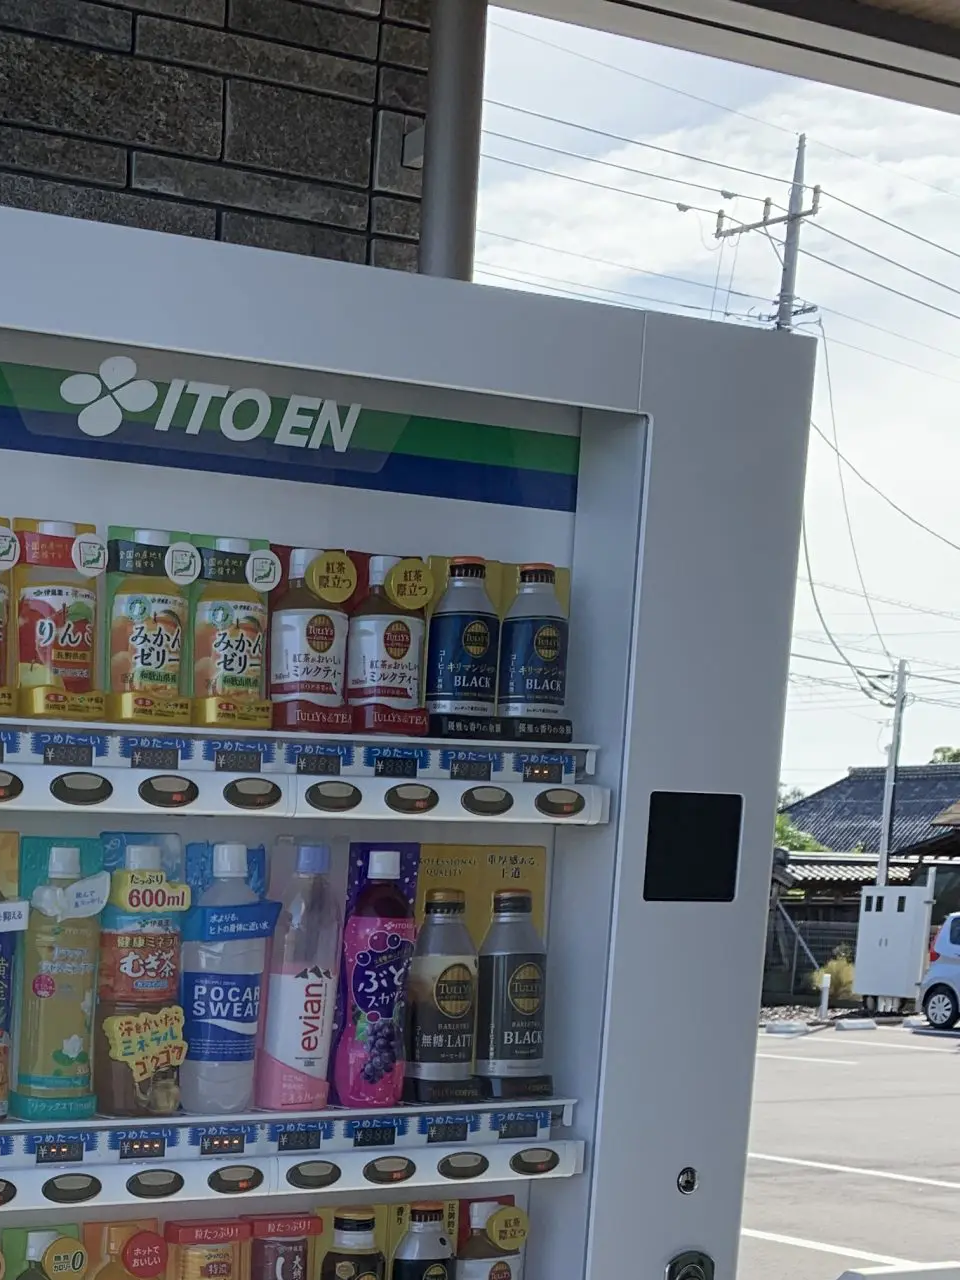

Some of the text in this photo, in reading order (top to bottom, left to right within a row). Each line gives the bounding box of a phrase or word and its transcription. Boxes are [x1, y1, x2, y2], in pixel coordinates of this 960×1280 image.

[154, 378, 362, 453] ITO EN
[325, 562, 345, 575] 紅茶
[403, 570, 422, 582] 紅茶
[318, 575, 352, 589] 際立つ
[396, 583, 427, 598] 際立つ
[130, 626, 181, 649] みかん
[213, 632, 262, 656] みかん
[134, 646, 179, 669] ゼリー
[217, 653, 261, 675] ゼリー
[291, 665, 341, 679] ミルクティー
[368, 671, 418, 685] ミルクティー
[454, 675, 491, 689] BLACK
[526, 678, 562, 692] BLACK
[130, 874, 164, 885] たっぷり
[128, 888, 185, 908] 600ml
[119, 949, 176, 978] むぎ茶
[298, 981, 323, 1054] evian
[122, 1031, 178, 1057] ミネラル
[503, 1031, 543, 1046] BLACK
[135, 1043, 184, 1078] ゴクゴク
[133, 1245, 160, 1258] ホットで
[132, 1255, 161, 1268] おいしい
